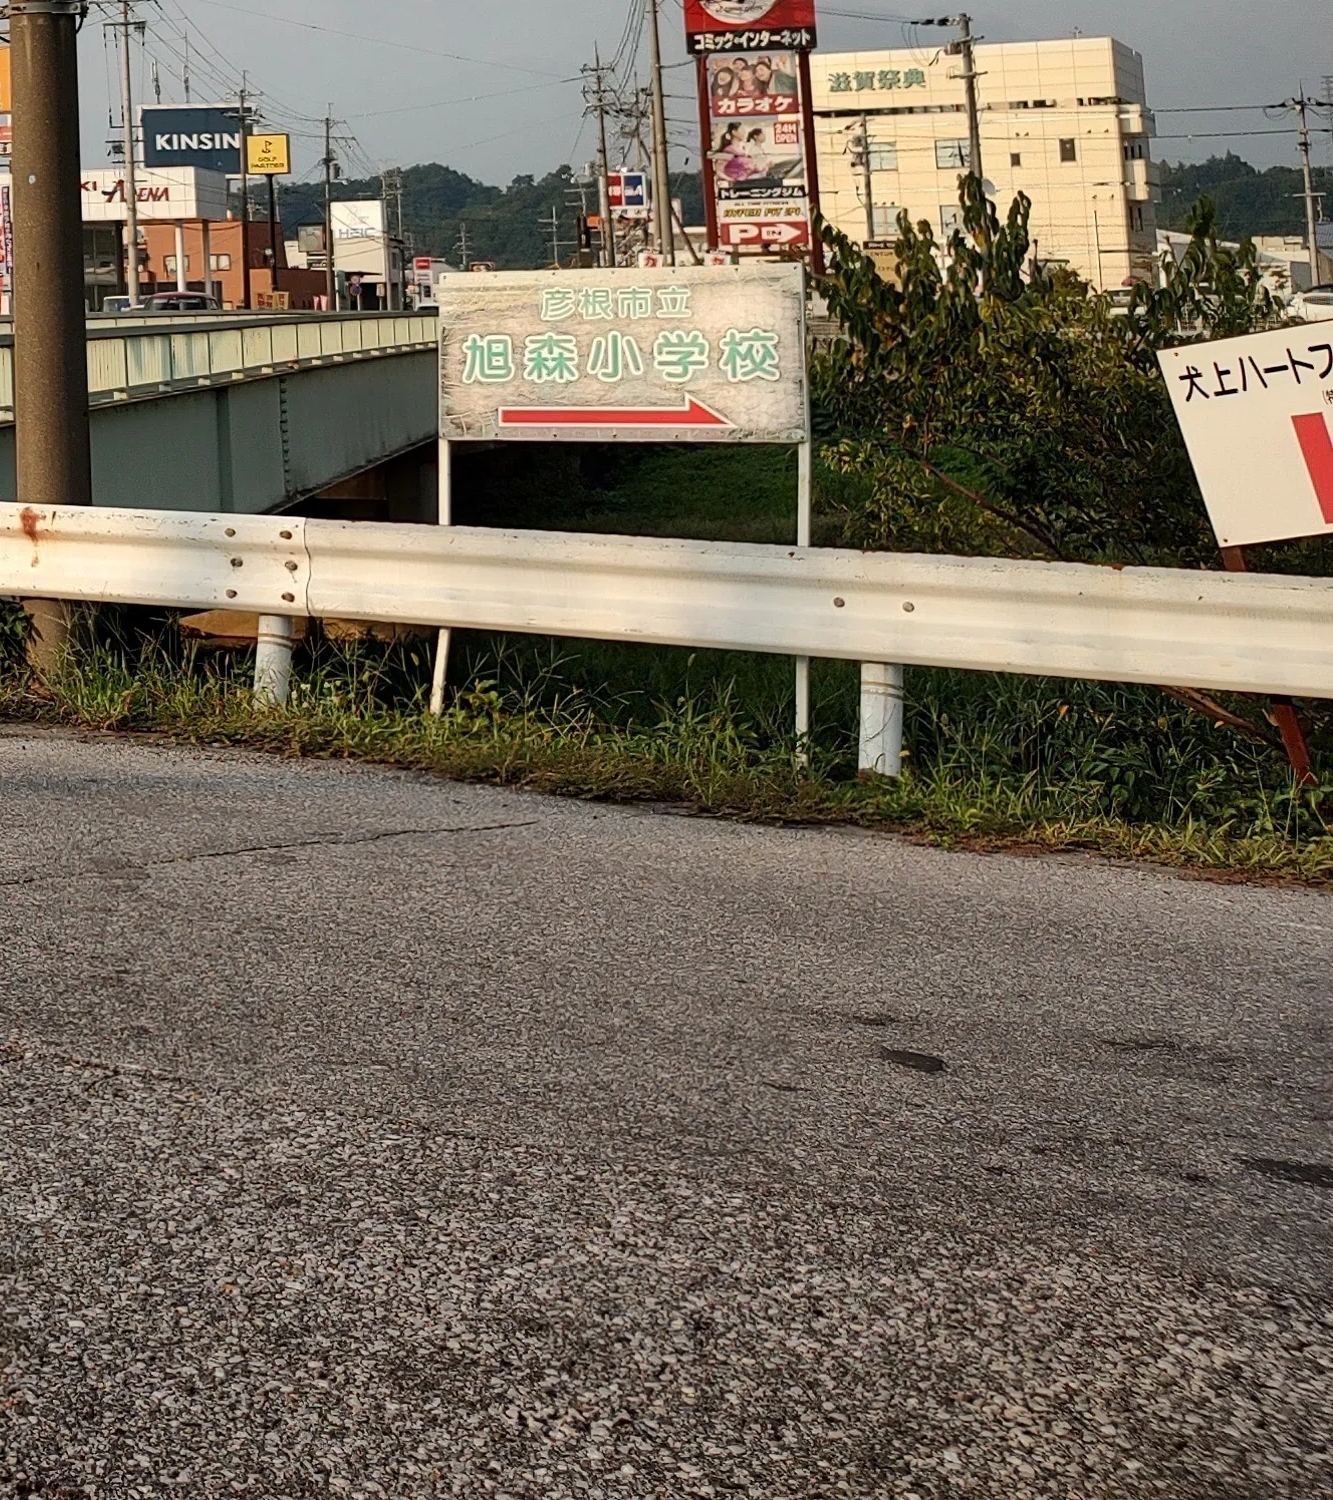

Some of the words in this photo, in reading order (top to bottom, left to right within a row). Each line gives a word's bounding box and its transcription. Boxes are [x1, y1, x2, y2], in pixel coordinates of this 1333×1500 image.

[717, 97, 793, 114] カラオケ
[721, 187, 803, 199] トレーニングジム
[729, 224, 759, 244] P
[541, 287, 692, 320] 彦根市立
[462, 328, 781, 384] 旭森小学校
[1179, 343, 1333, 402] 犬上ハートフ
